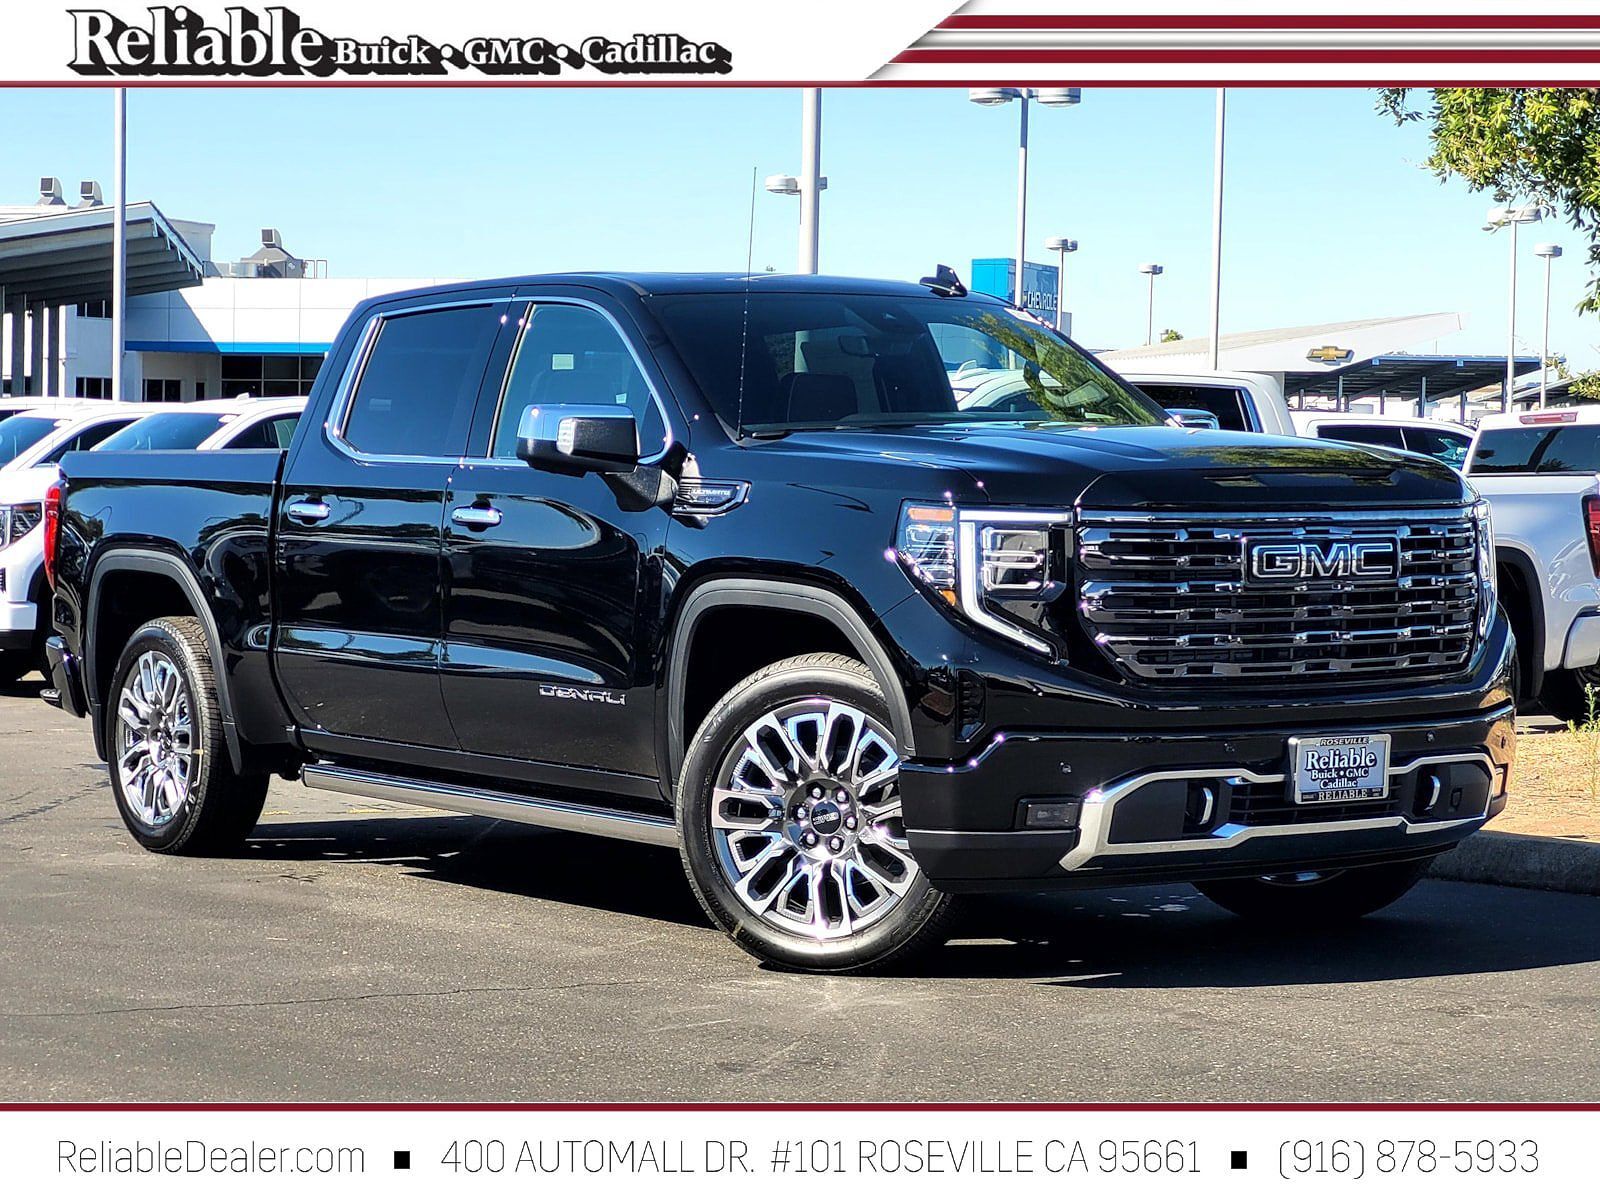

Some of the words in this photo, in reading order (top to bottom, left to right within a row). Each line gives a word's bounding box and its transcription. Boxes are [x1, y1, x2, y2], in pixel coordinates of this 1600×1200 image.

[1027, 291, 1058, 311] CHEVROLE
[1251, 542, 1394, 579] GMC
[539, 684, 626, 706] DENALI
[1320, 737, 1369, 746] ROSEVILLE
[1305, 747, 1377, 770] Reliable
[1311, 769, 1339, 780] Buick
[1345, 767, 1369, 778] GMC
[1319, 779, 1358, 789] Cadillac
[1318, 788, 1368, 801] RELIABLE
